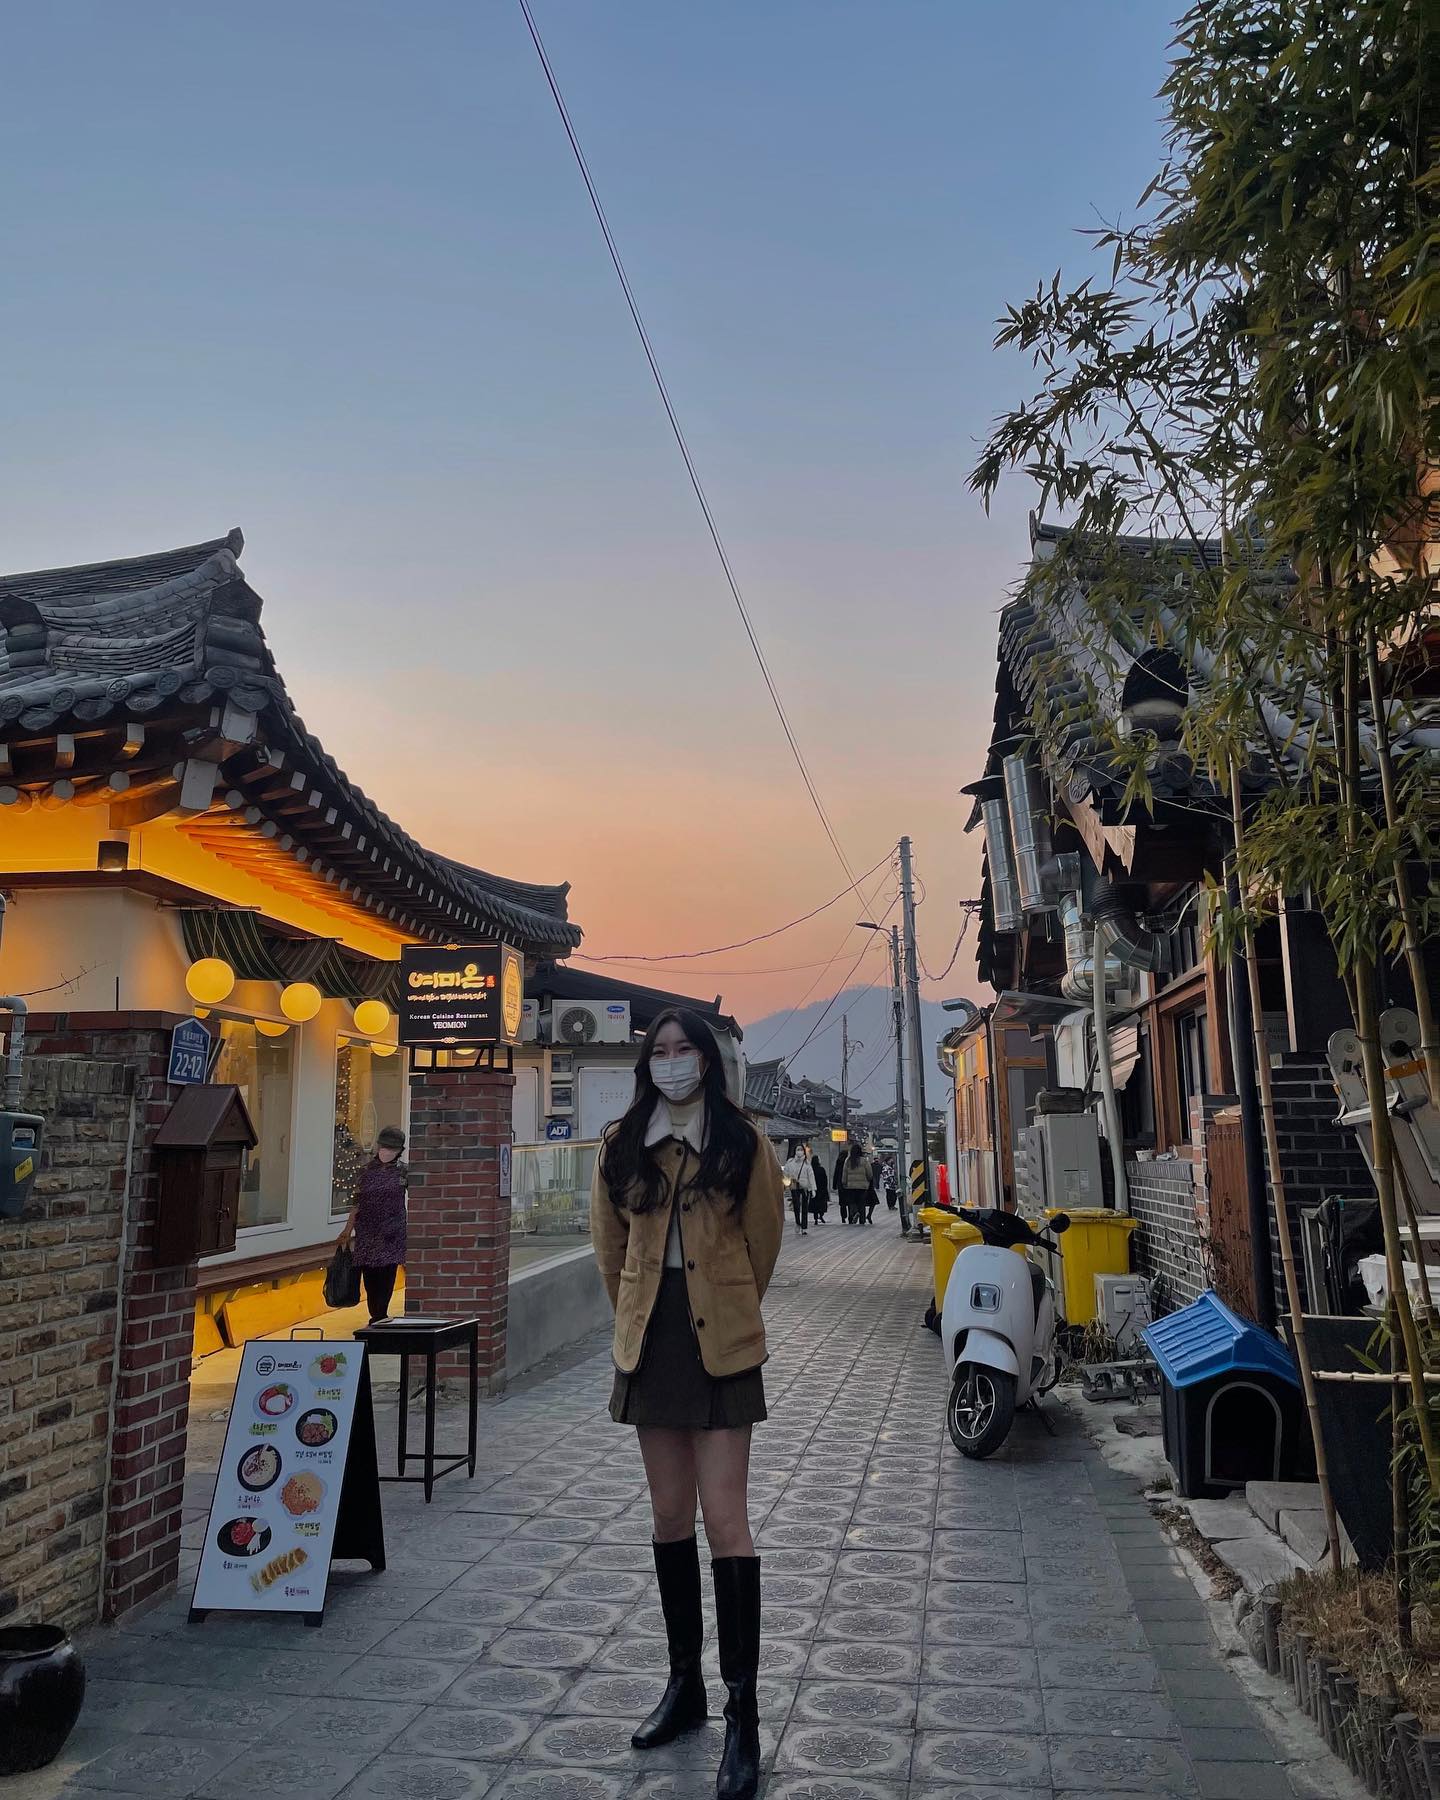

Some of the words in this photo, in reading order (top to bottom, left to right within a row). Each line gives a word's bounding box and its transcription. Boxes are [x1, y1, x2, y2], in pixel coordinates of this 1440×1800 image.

[433, 1021, 467, 1029] YEOMION
[174, 1052, 203, 1079] 22-12
[550, 1126, 569, 1137] ADT
